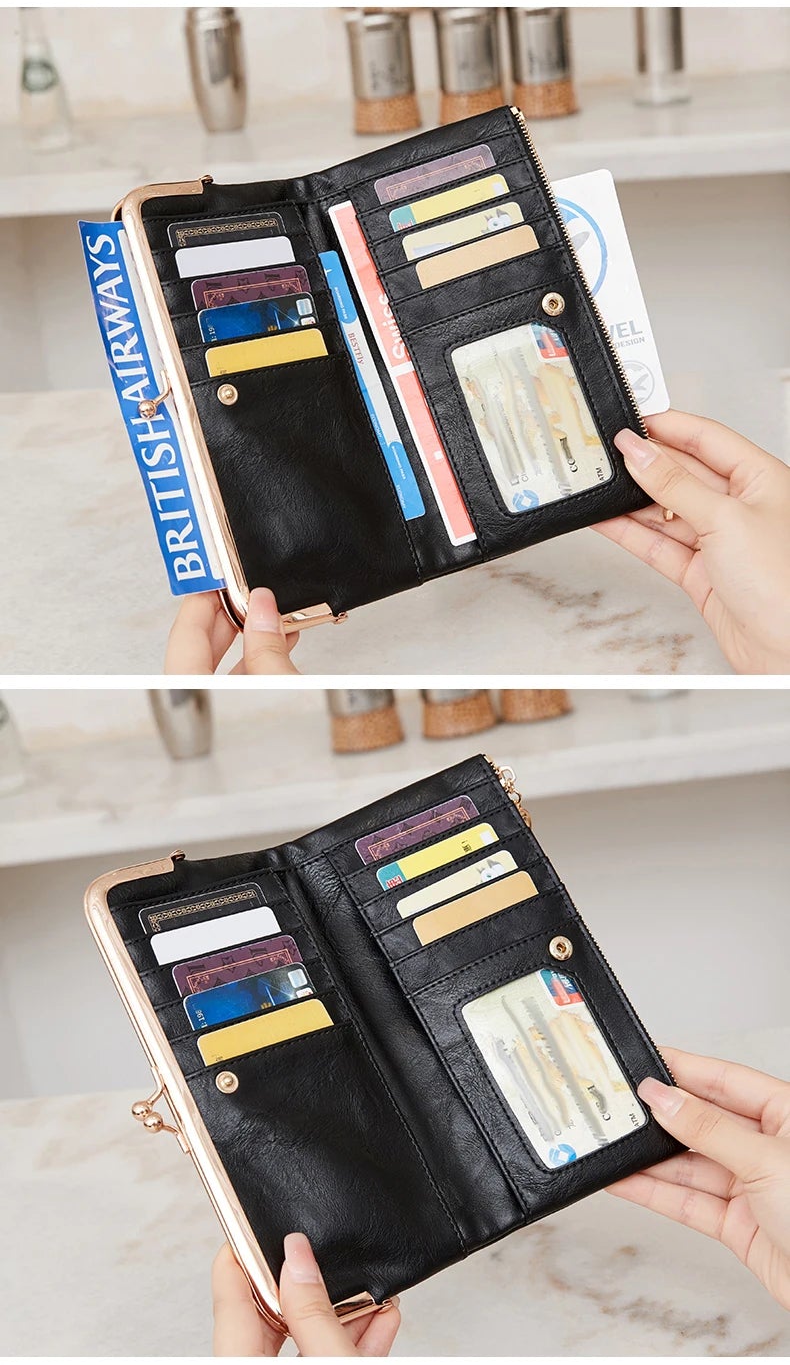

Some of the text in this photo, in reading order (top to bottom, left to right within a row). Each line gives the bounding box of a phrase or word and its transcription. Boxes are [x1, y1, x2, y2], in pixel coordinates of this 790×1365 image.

[615, 336, 646, 349] DESIGN
[86, 234, 207, 582] BRITISH AIRWAYS
[628, 1112, 640, 1127] ATM
